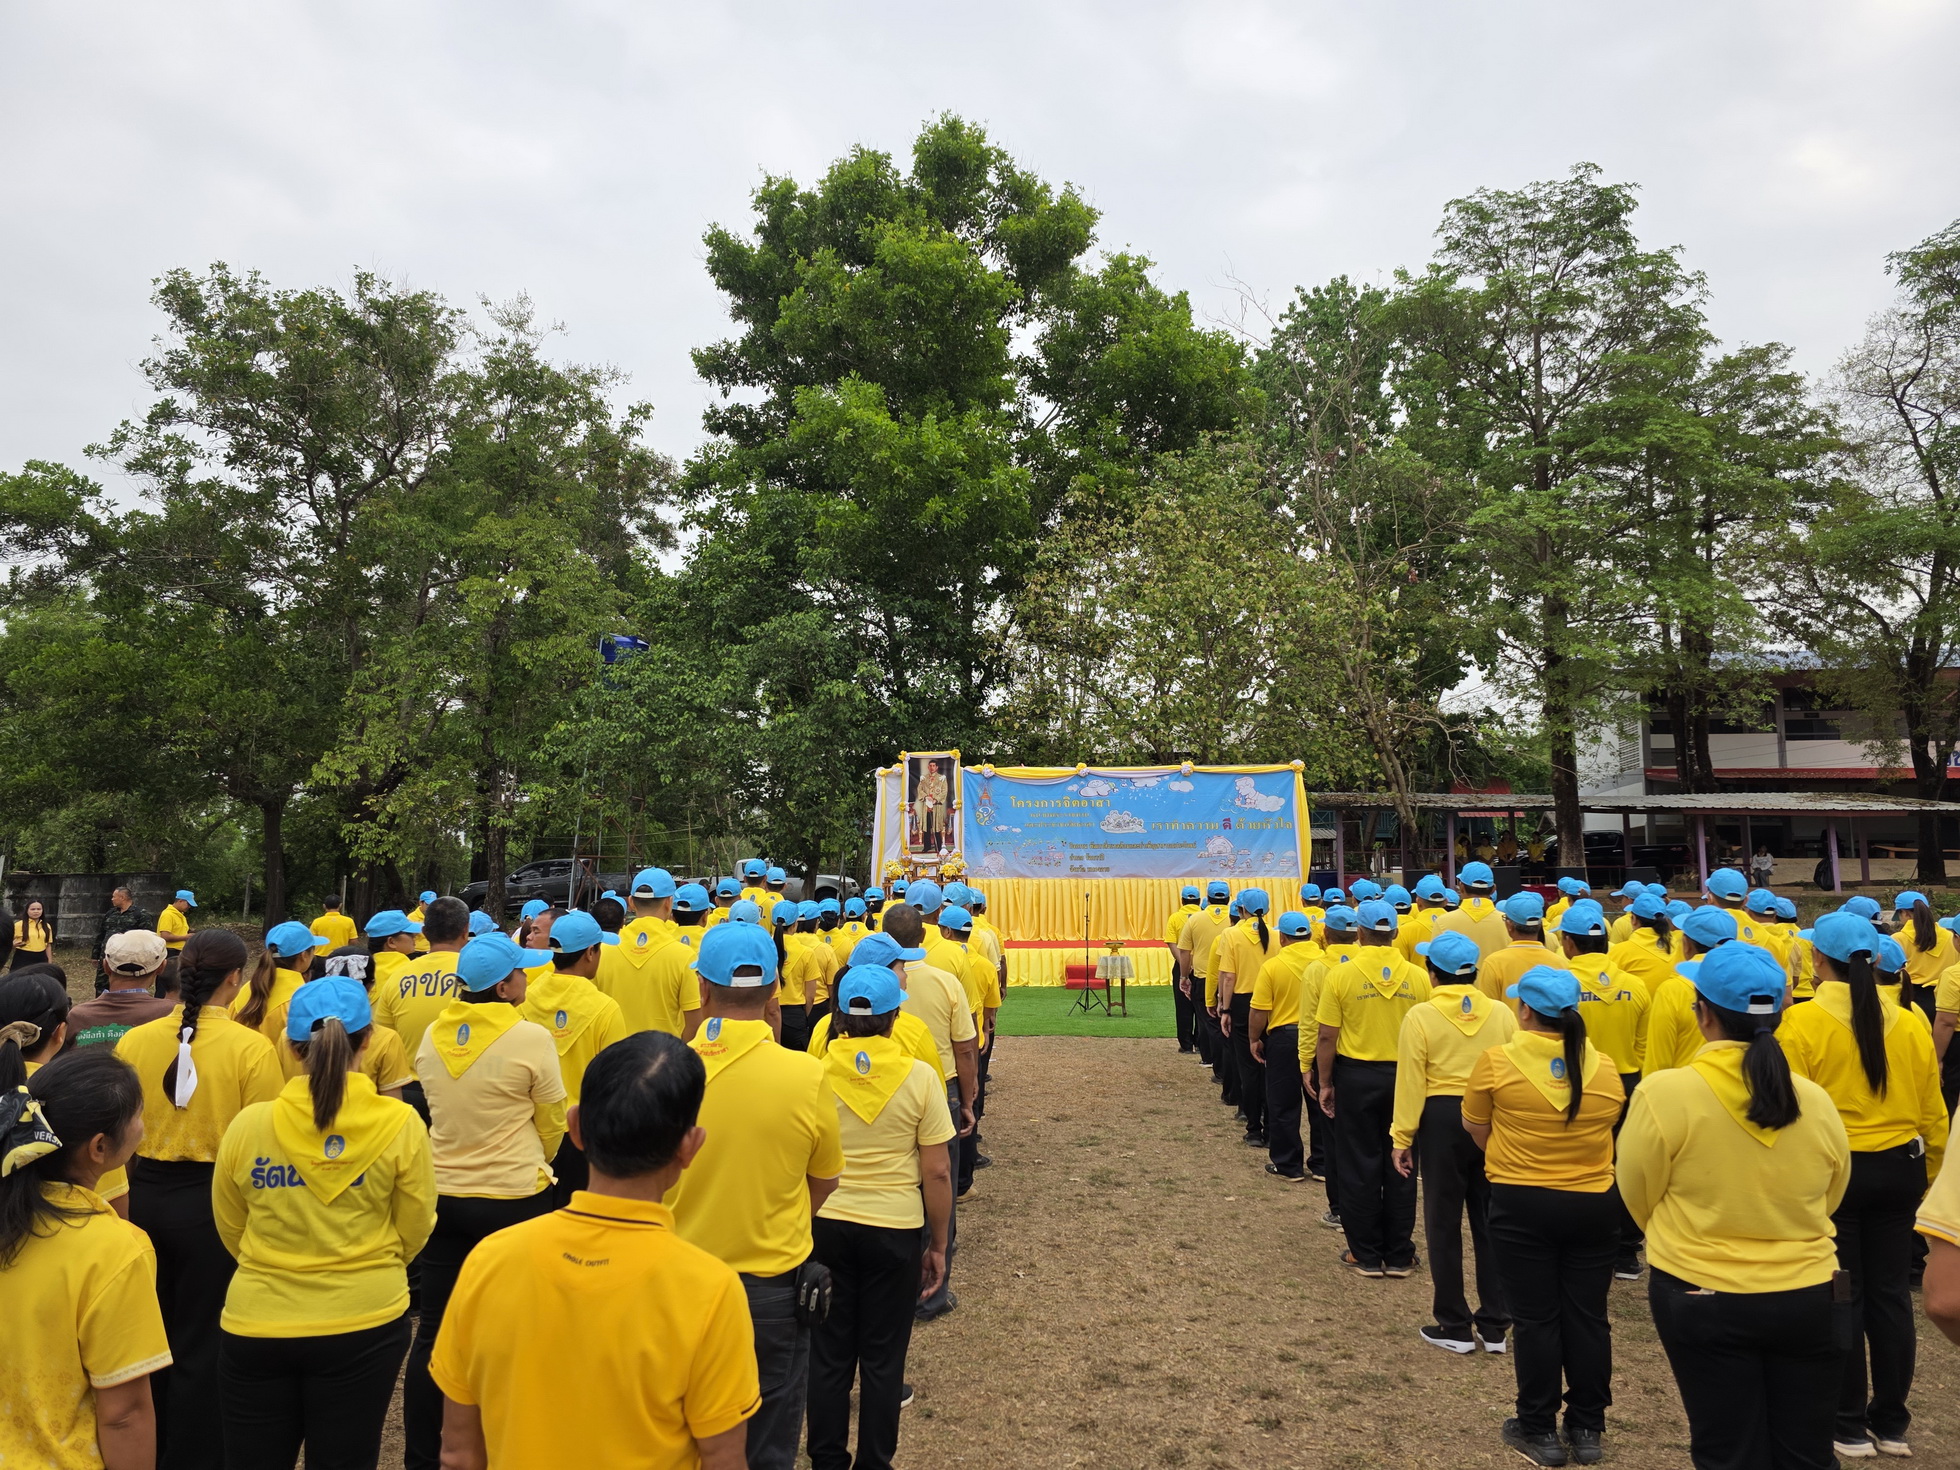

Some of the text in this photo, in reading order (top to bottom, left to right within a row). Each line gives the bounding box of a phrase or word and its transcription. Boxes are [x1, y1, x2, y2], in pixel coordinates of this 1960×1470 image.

[1010, 795, 1111, 808] โครงการจิตอาสา
[1151, 817, 1293, 830] เราทำความ ดี ด้วยหัวใจ
